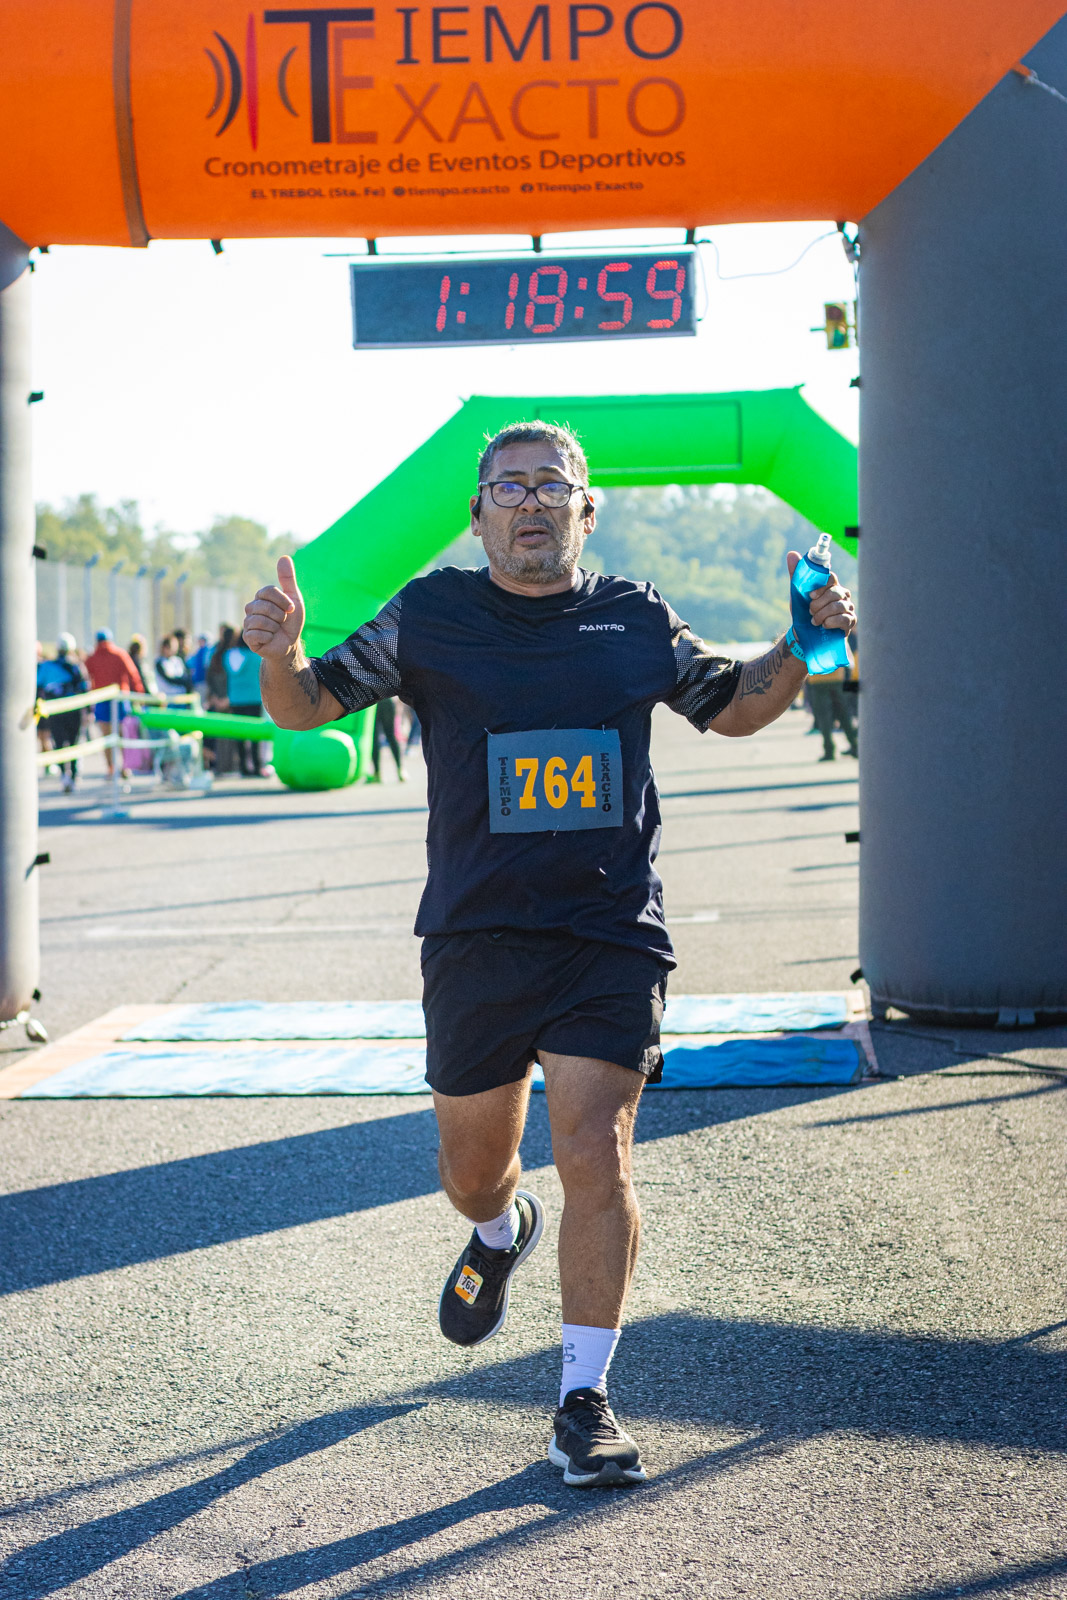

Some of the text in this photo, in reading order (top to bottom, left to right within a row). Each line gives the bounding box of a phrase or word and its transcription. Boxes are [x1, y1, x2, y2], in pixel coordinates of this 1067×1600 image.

[204, 148, 687, 178] Cronometraje de Eventos Deportivos
[250, 188, 267, 199] EL
[537, 182, 592, 195] Tiempo
[594, 180, 644, 192] Exacto
[578, 623, 625, 632] PANTRO
[498, 756, 511, 816] TIEMPO
[515, 755, 596, 809] 764
[600, 752, 612, 813] EXACTO
[461, 1276, 476, 1294] 764
